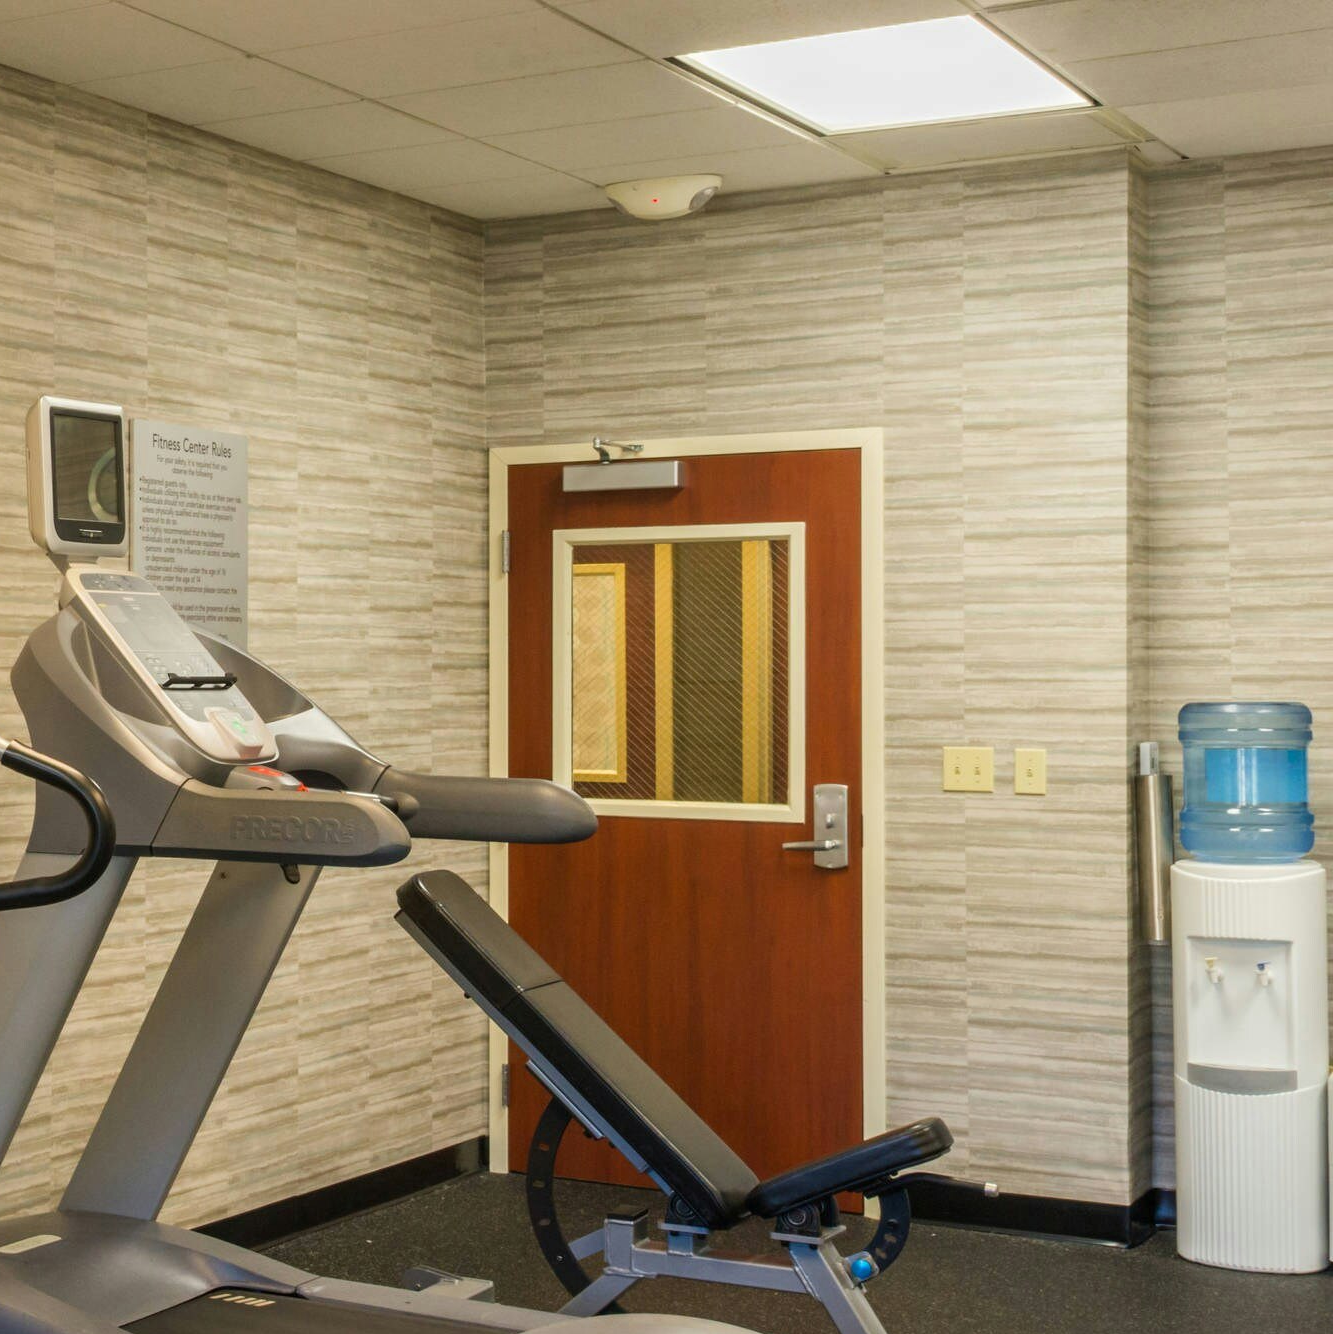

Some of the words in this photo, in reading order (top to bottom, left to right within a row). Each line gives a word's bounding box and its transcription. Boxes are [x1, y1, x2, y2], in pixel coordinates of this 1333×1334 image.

[153, 433, 181, 451] Fitness
[183, 437, 209, 454] Center
[212, 441, 231, 458] Rules
